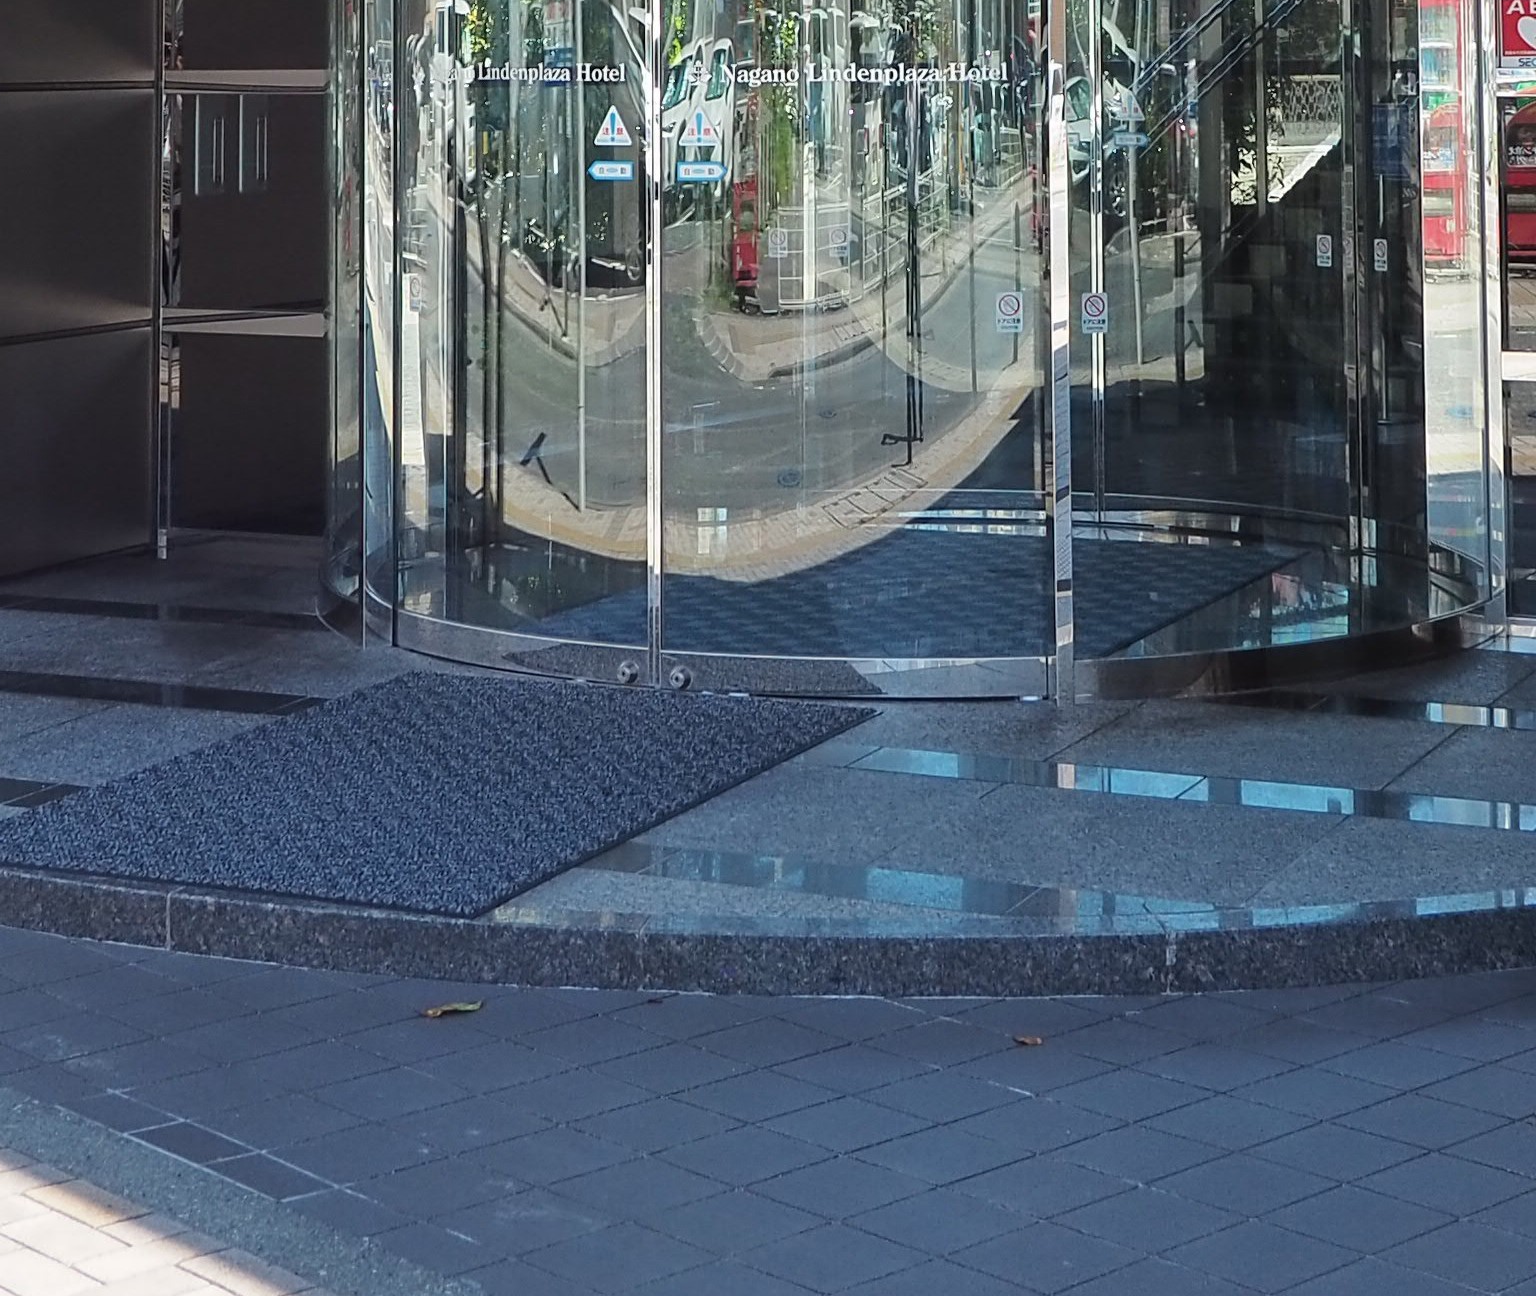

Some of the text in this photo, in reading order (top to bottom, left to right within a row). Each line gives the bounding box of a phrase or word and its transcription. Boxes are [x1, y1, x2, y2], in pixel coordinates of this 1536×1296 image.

[477, 63, 571, 85] Lindenplaza
[576, 63, 626, 82] Hotel
[720, 62, 1008, 87] Nagano Lindenplaza Hotel
